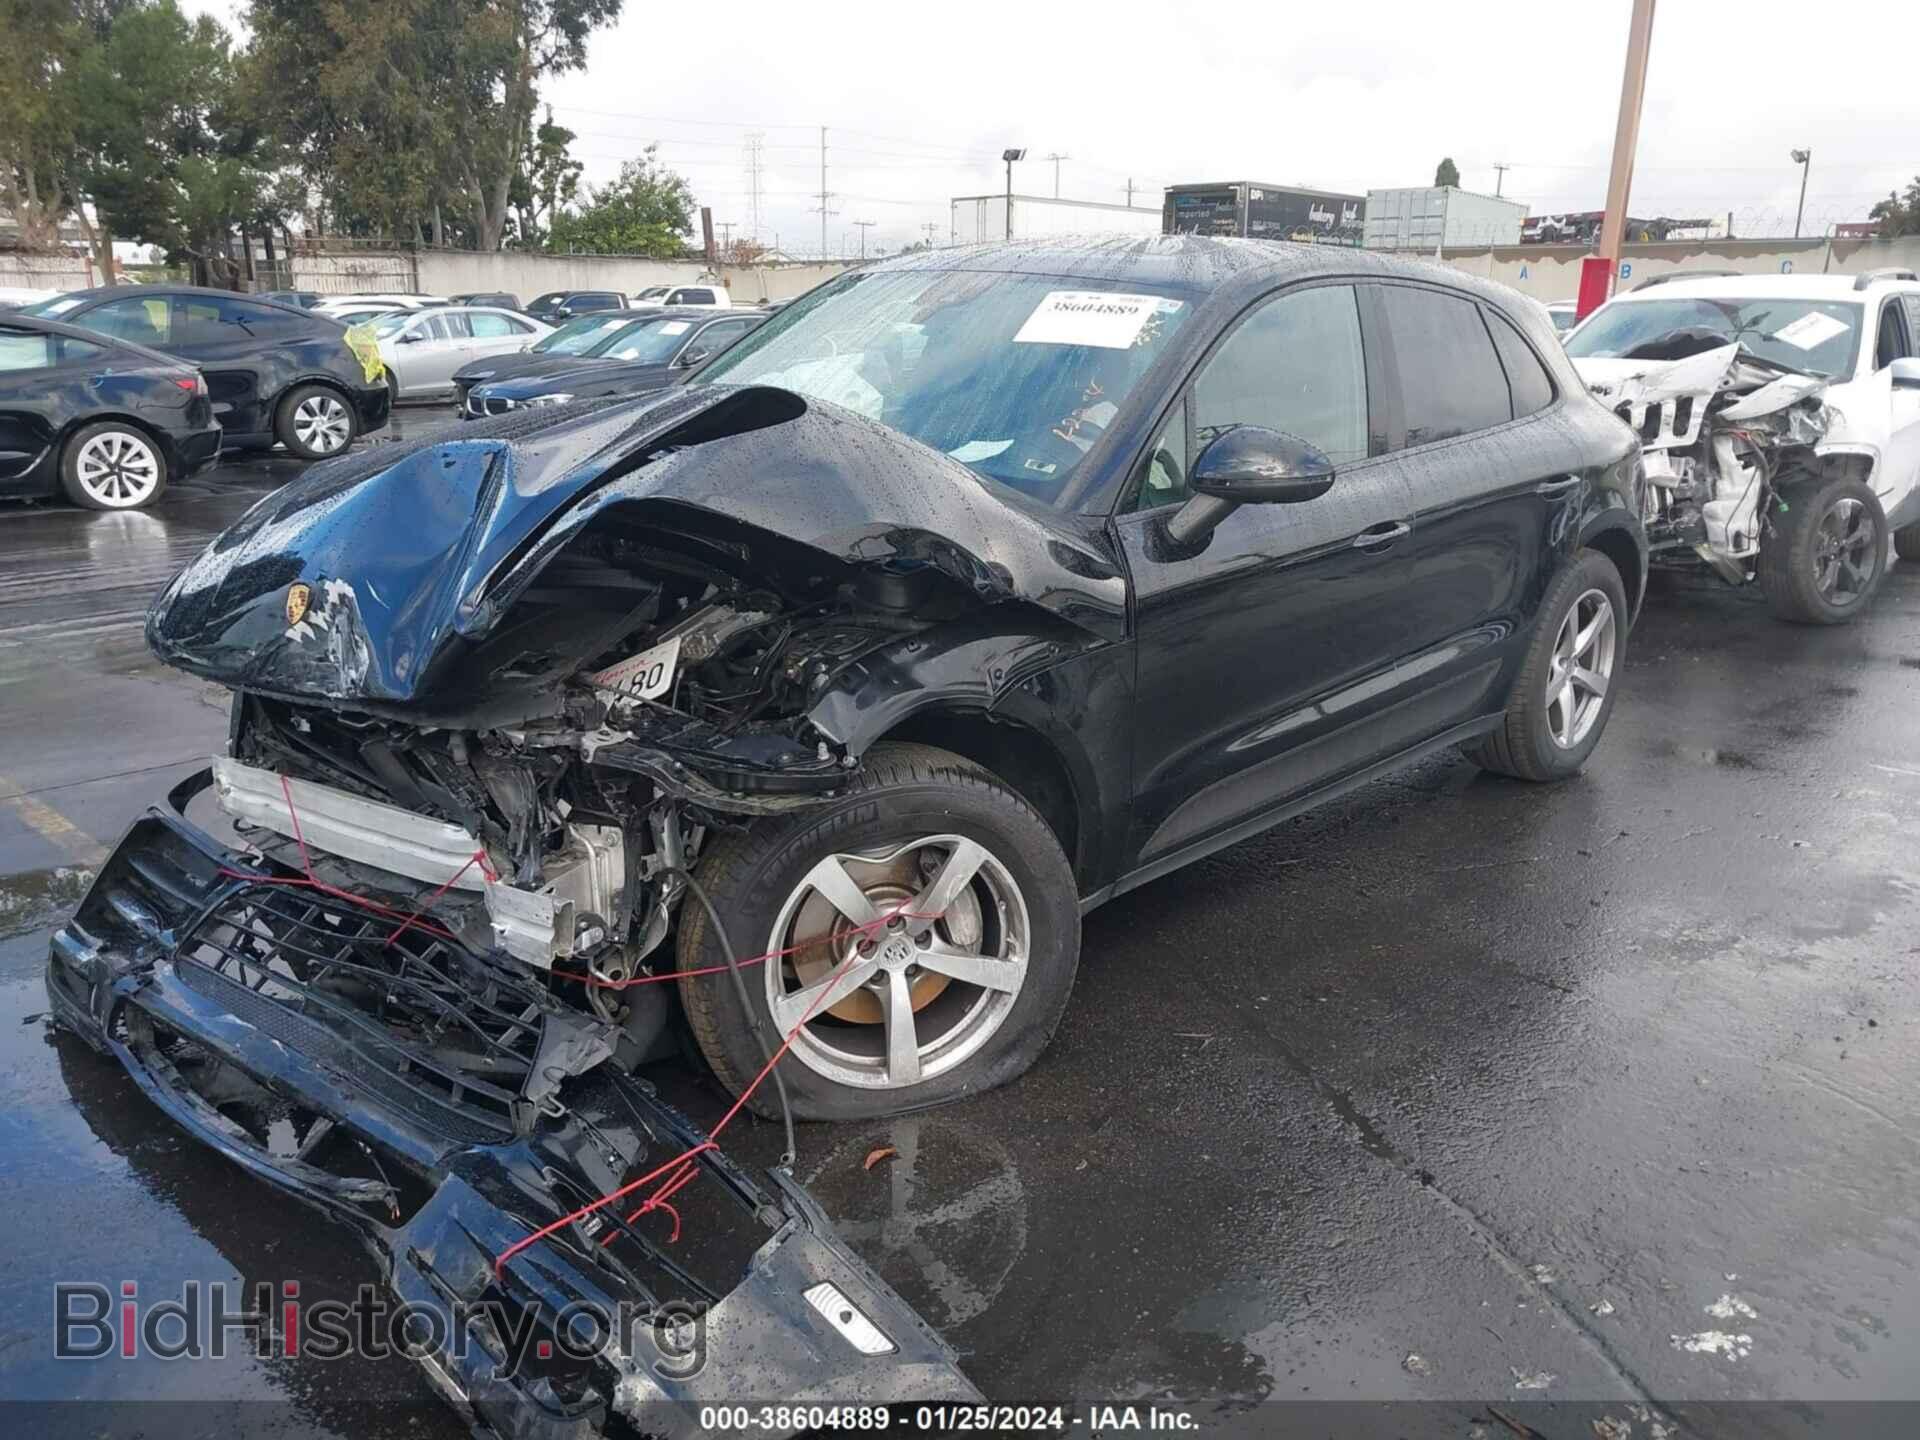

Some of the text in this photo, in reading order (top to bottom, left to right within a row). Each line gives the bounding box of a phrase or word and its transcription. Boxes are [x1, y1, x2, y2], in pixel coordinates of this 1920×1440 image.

[1519, 265, 1528, 279] A
[1620, 264, 1632, 279] B
[1049, 301, 1140, 315] 38604889
